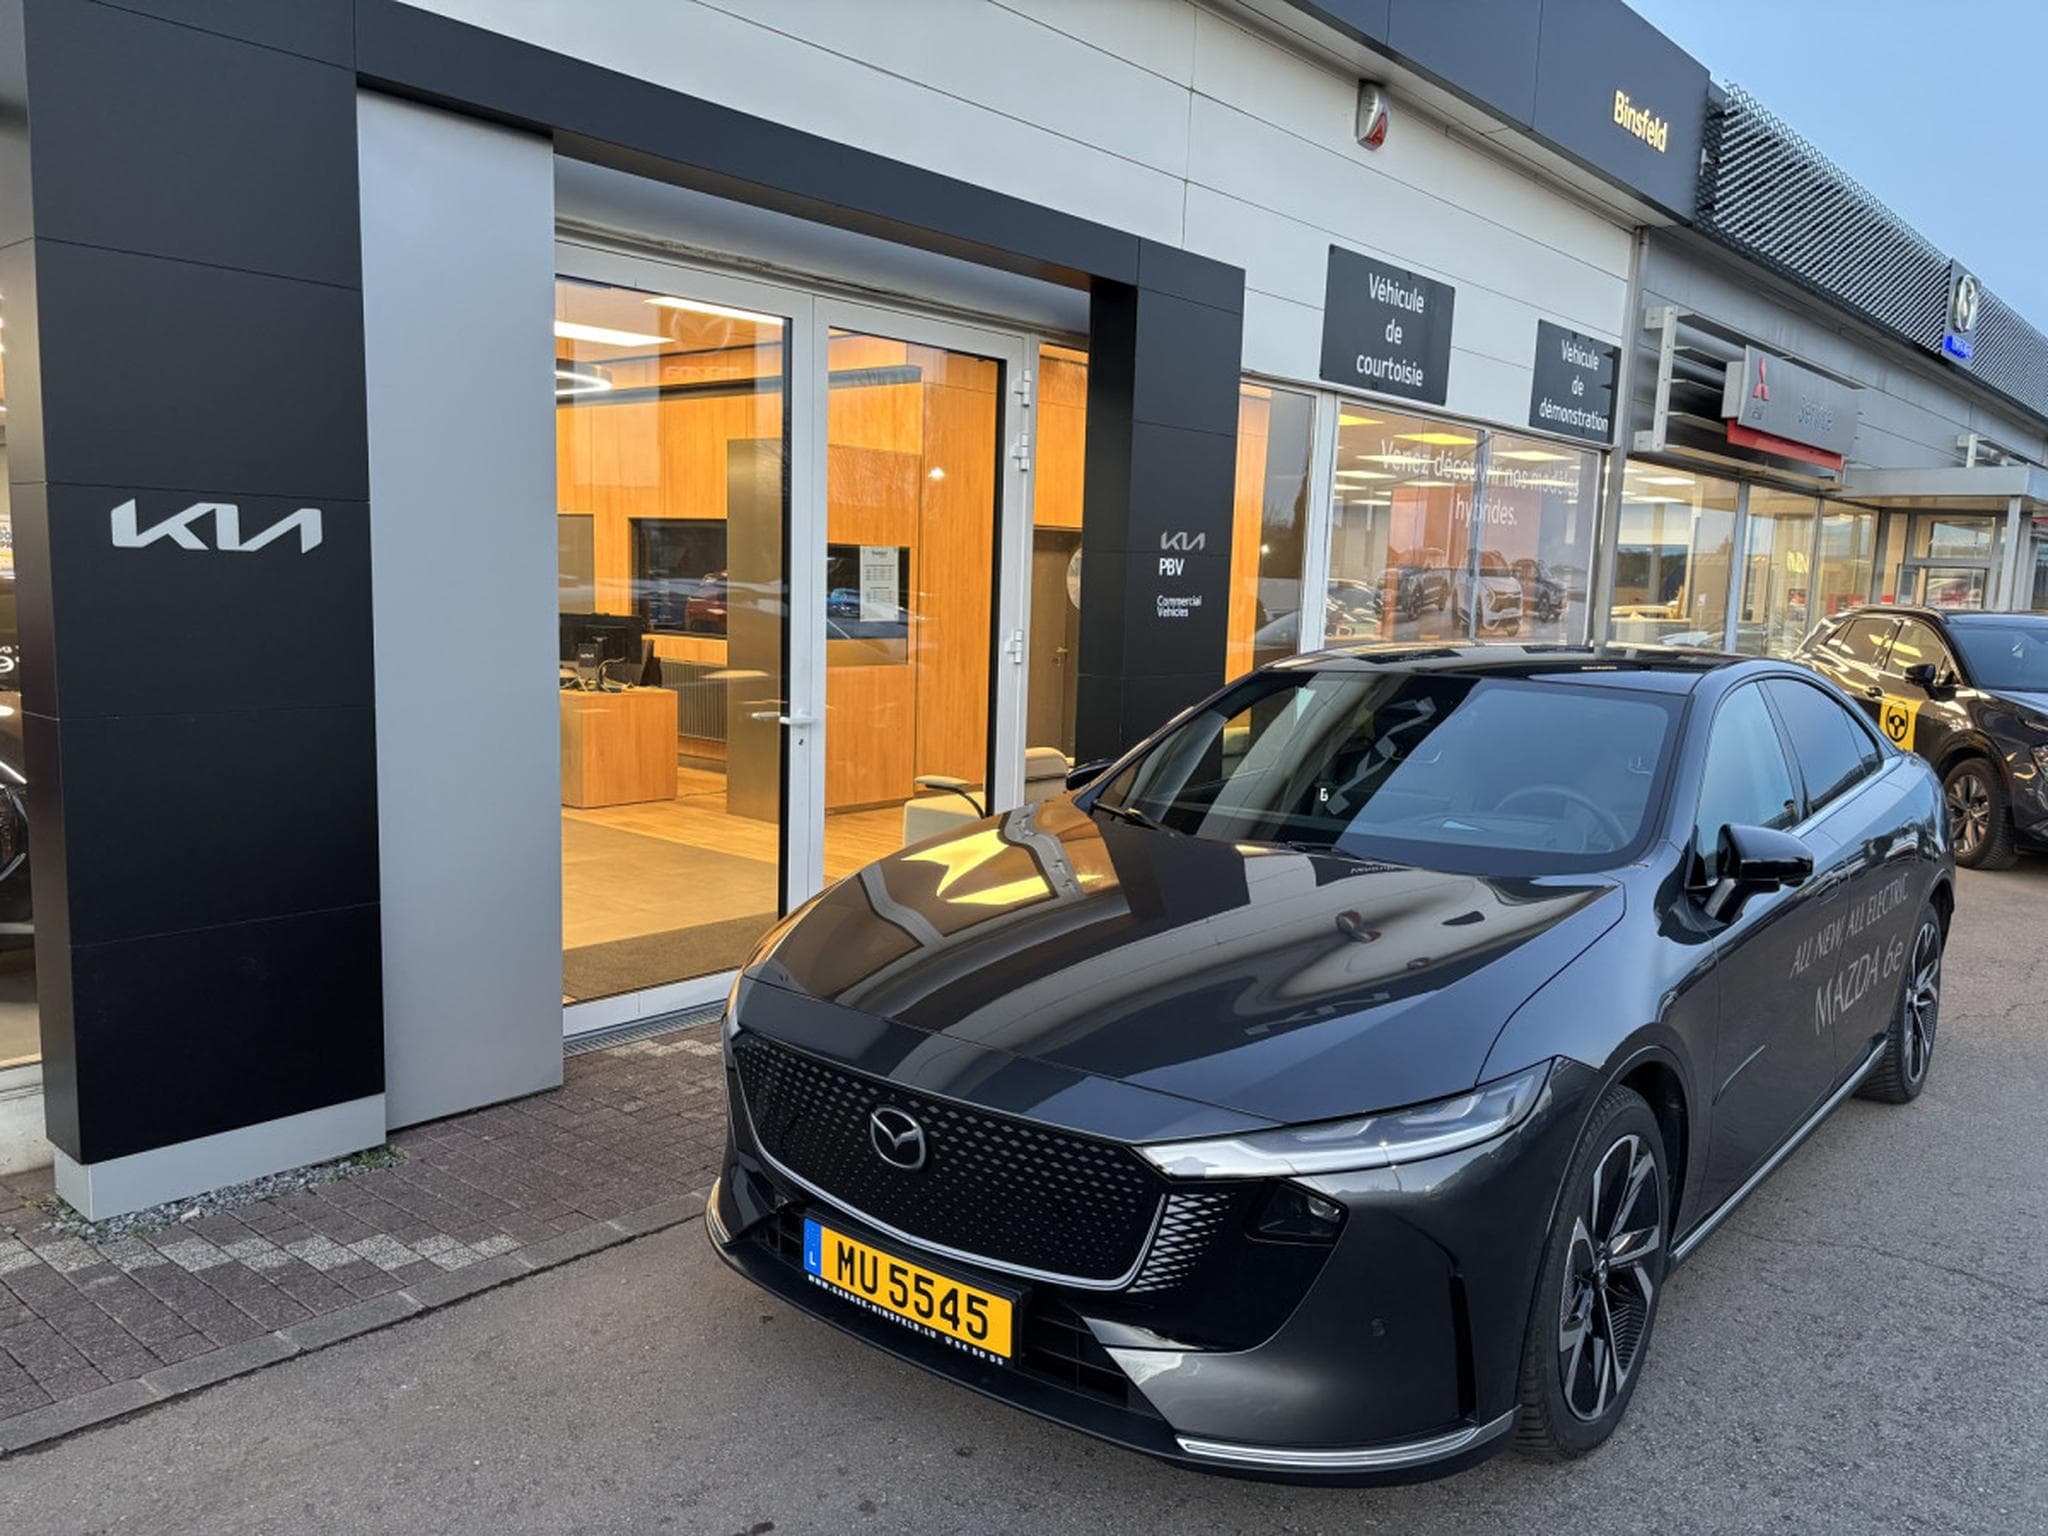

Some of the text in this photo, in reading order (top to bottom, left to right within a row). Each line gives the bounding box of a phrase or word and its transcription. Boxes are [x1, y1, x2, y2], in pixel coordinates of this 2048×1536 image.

[1613, 89, 1668, 153] Binsfeld
[1369, 272, 1425, 313] Véhicule
[1385, 318, 1403, 344] de
[1356, 354, 1424, 387] courtoisie
[1571, 375, 1584, 396] de
[1539, 397, 1609, 432] démonstration
[1381, 439, 1430, 476] Venez
[1504, 468, 1529, 490] nos
[111, 498, 323, 554] KIA
[1159, 557, 1185, 576] PBV
[1157, 594, 1202, 607] Commercial
[1789, 936, 1813, 979] ALL
[1845, 903, 1865, 942] ALL
[1815, 933, 1904, 1036] MAZDA 6e
[809, 1240, 989, 1341] L MU 5545
